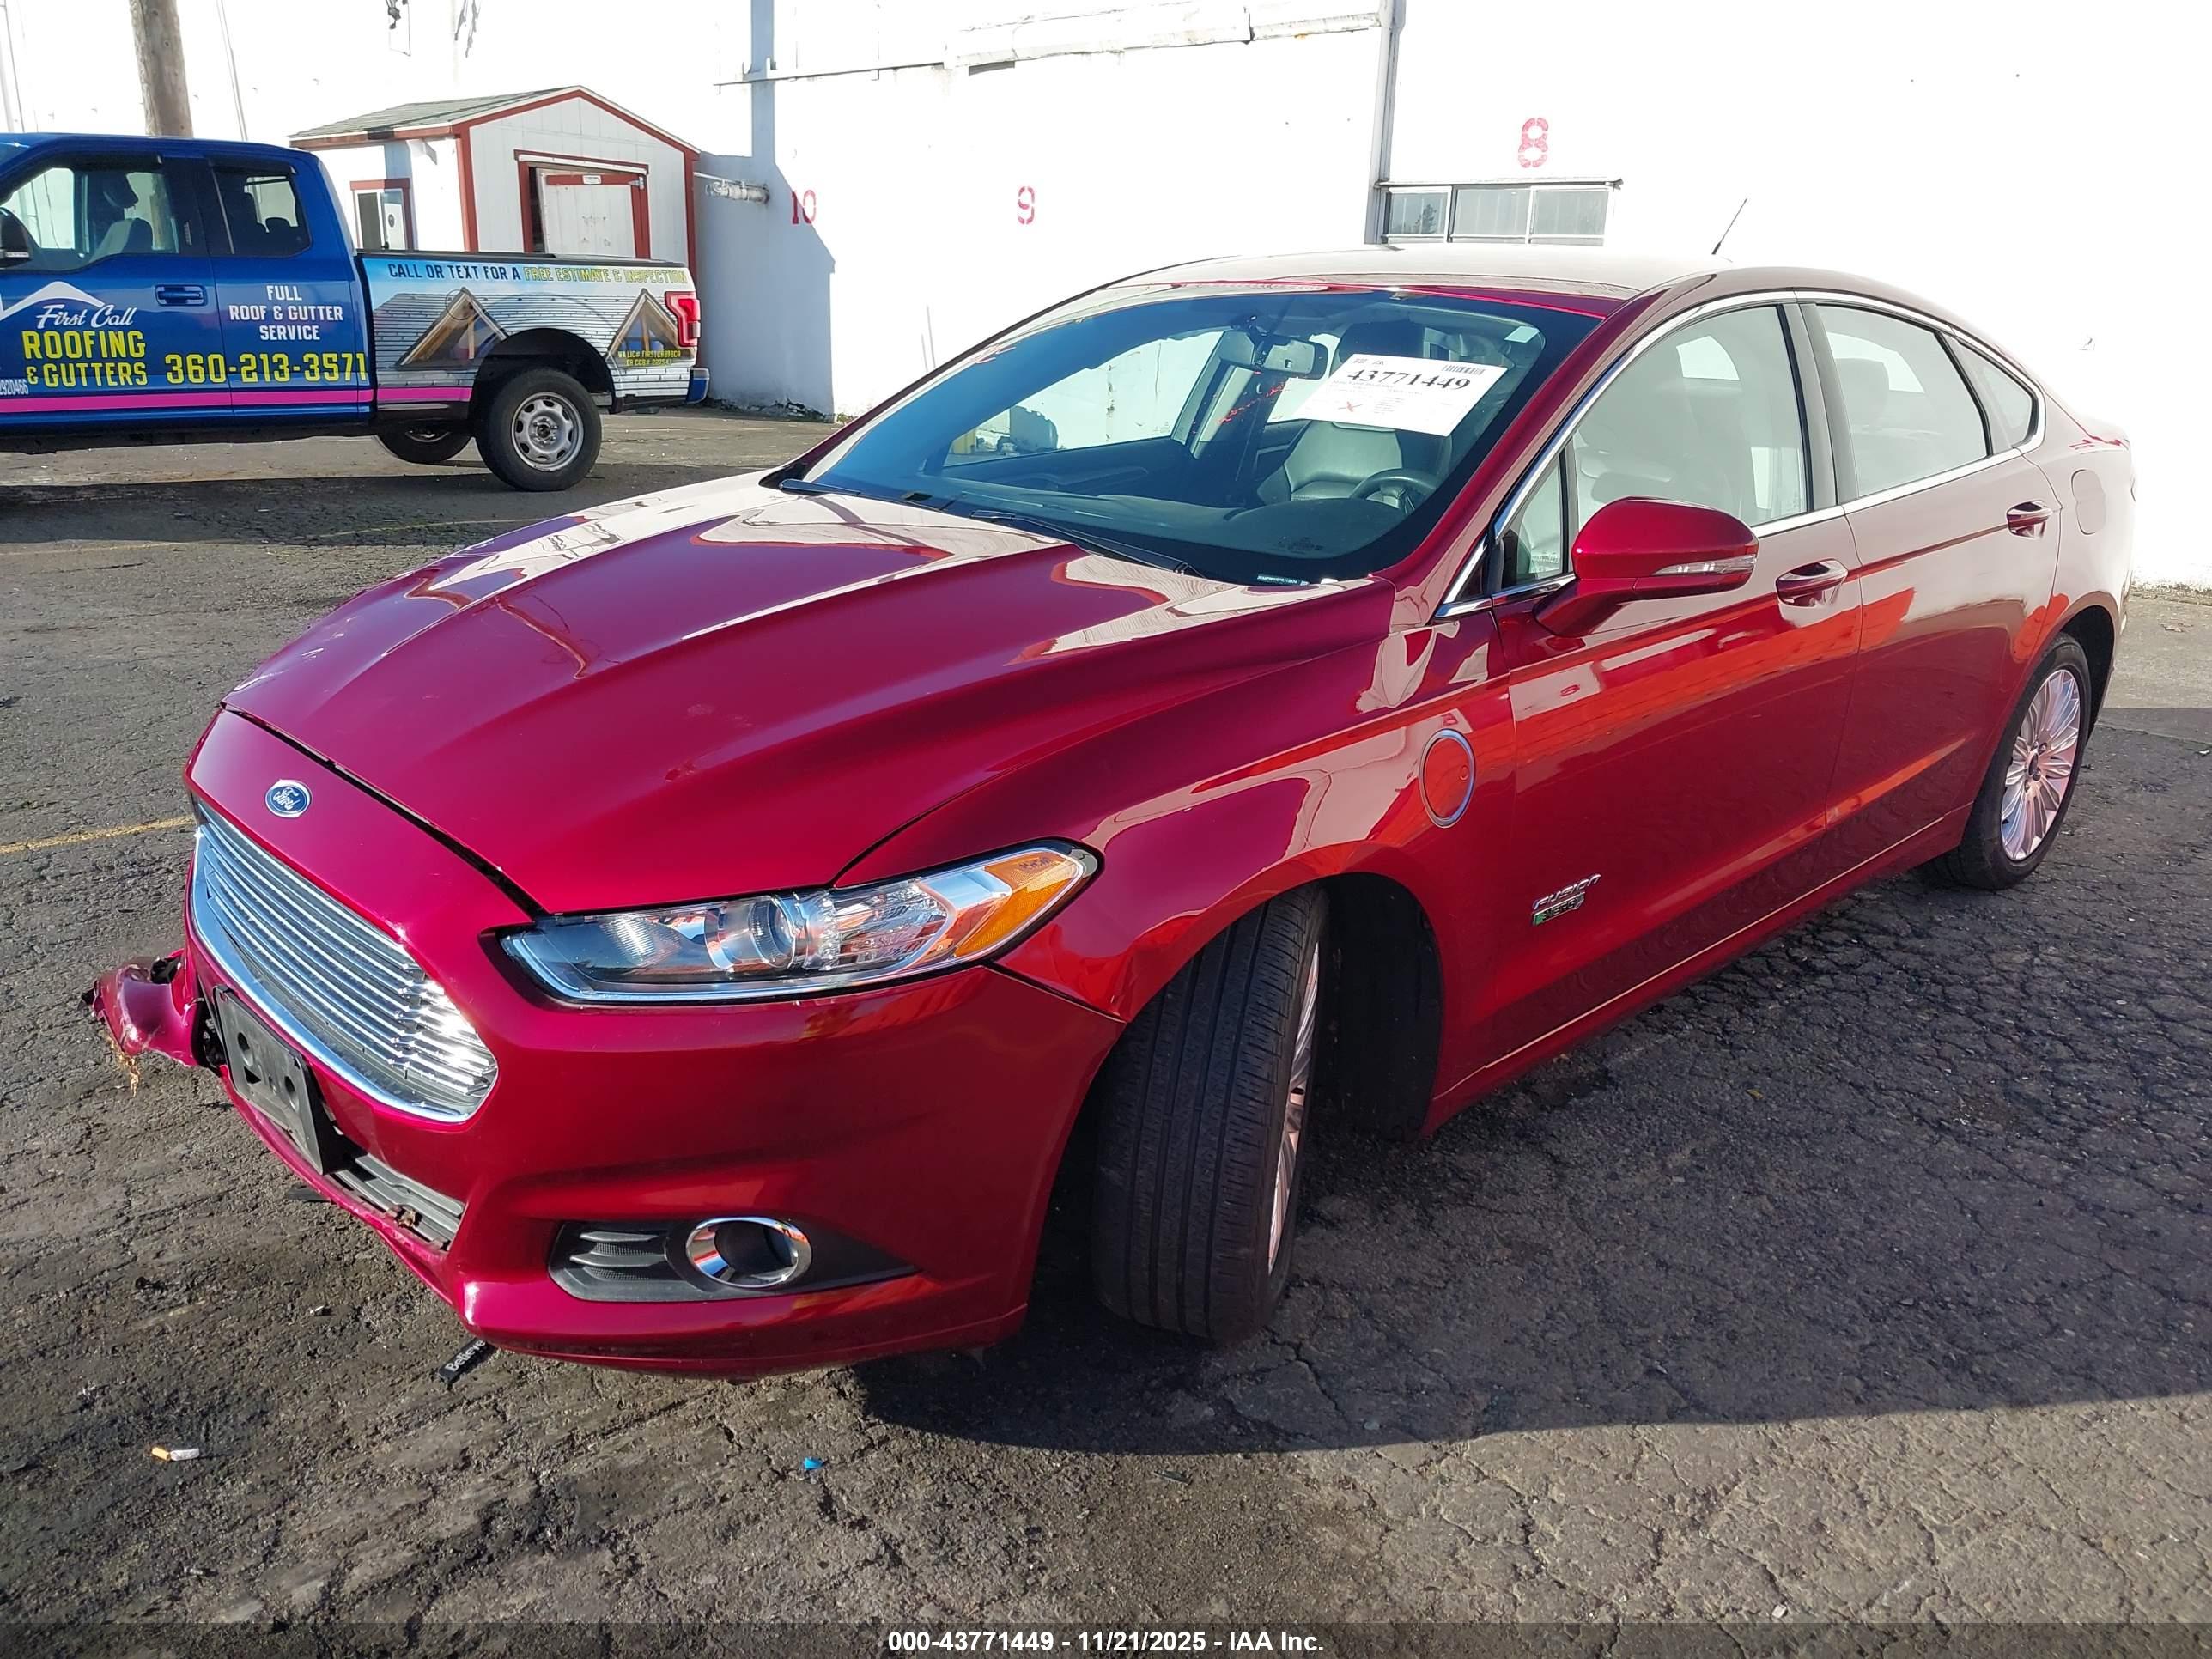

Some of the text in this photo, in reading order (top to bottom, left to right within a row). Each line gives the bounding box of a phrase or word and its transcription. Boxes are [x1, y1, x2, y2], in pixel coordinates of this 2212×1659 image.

[1518, 117, 1549, 168] 8
[792, 189, 816, 224] 10
[1018, 185, 1035, 225] 9
[388, 264, 422, 278] CALL
[426, 264, 445, 279] OR
[447, 265, 479, 280] TEXT
[483, 266, 508, 281] FOR
[512, 267, 521, 281] A
[523, 267, 554, 282] FREE
[557, 268, 612, 283] ESTIMATE
[623, 269, 688, 284] INSPECTION
[266, 285, 303, 301] FULL
[36, 304, 137, 329] First Call
[229, 305, 343, 321] ROOF & GUTTER
[21, 330, 146, 359] ROOFING
[259, 325, 320, 341] SERVICE
[27, 362, 148, 387] & GUTTERS
[164, 352, 368, 384] 360-213-3571
[1347, 369, 1471, 390] 43771449
[273, 786, 301, 811] Ford
[445, 1340, 486, 1371] Believe
